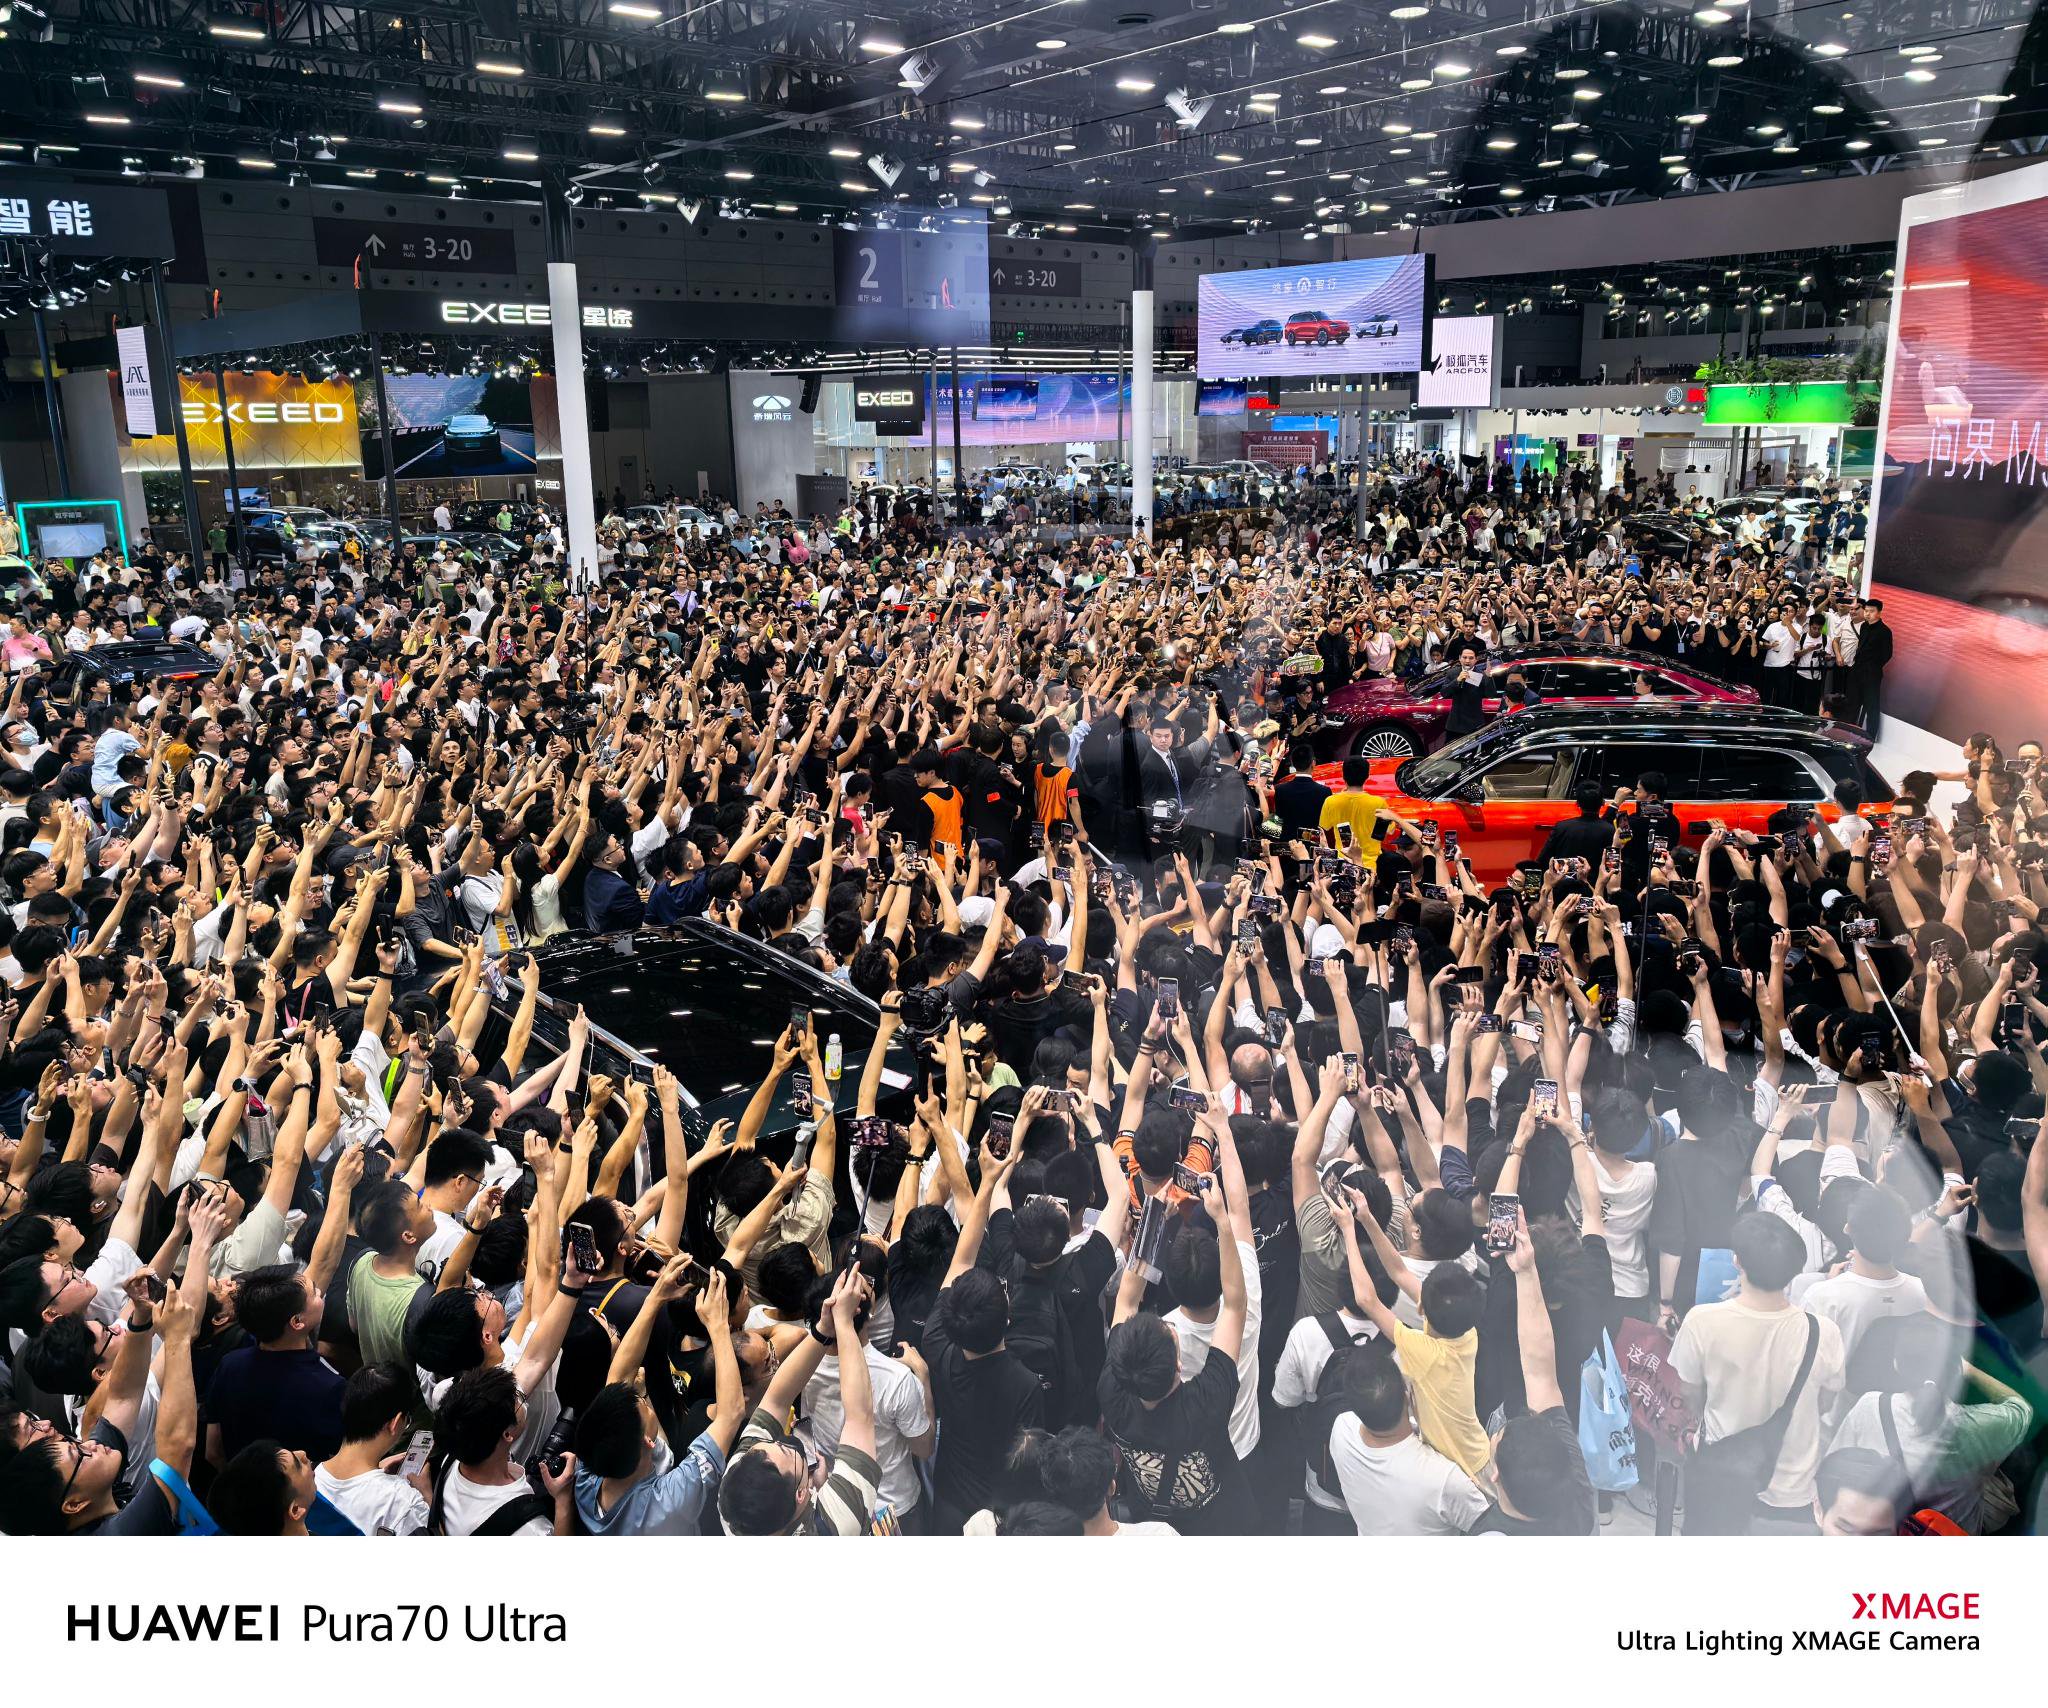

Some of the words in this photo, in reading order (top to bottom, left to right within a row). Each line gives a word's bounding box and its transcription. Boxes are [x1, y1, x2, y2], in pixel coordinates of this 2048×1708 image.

[424, 237, 472, 261] 3-20
[858, 247, 879, 289] 2
[1027, 269, 1057, 288] 3-20
[441, 301, 551, 326] EXEE
[582, 306, 633, 328] 星途
[1446, 354, 1488, 368] 极狐汽车
[1446, 367, 1488, 375] ARCFOX
[857, 391, 914, 407] EXEED
[180, 402, 344, 423] EXEED
[1927, 415, 1996, 481] 问界
